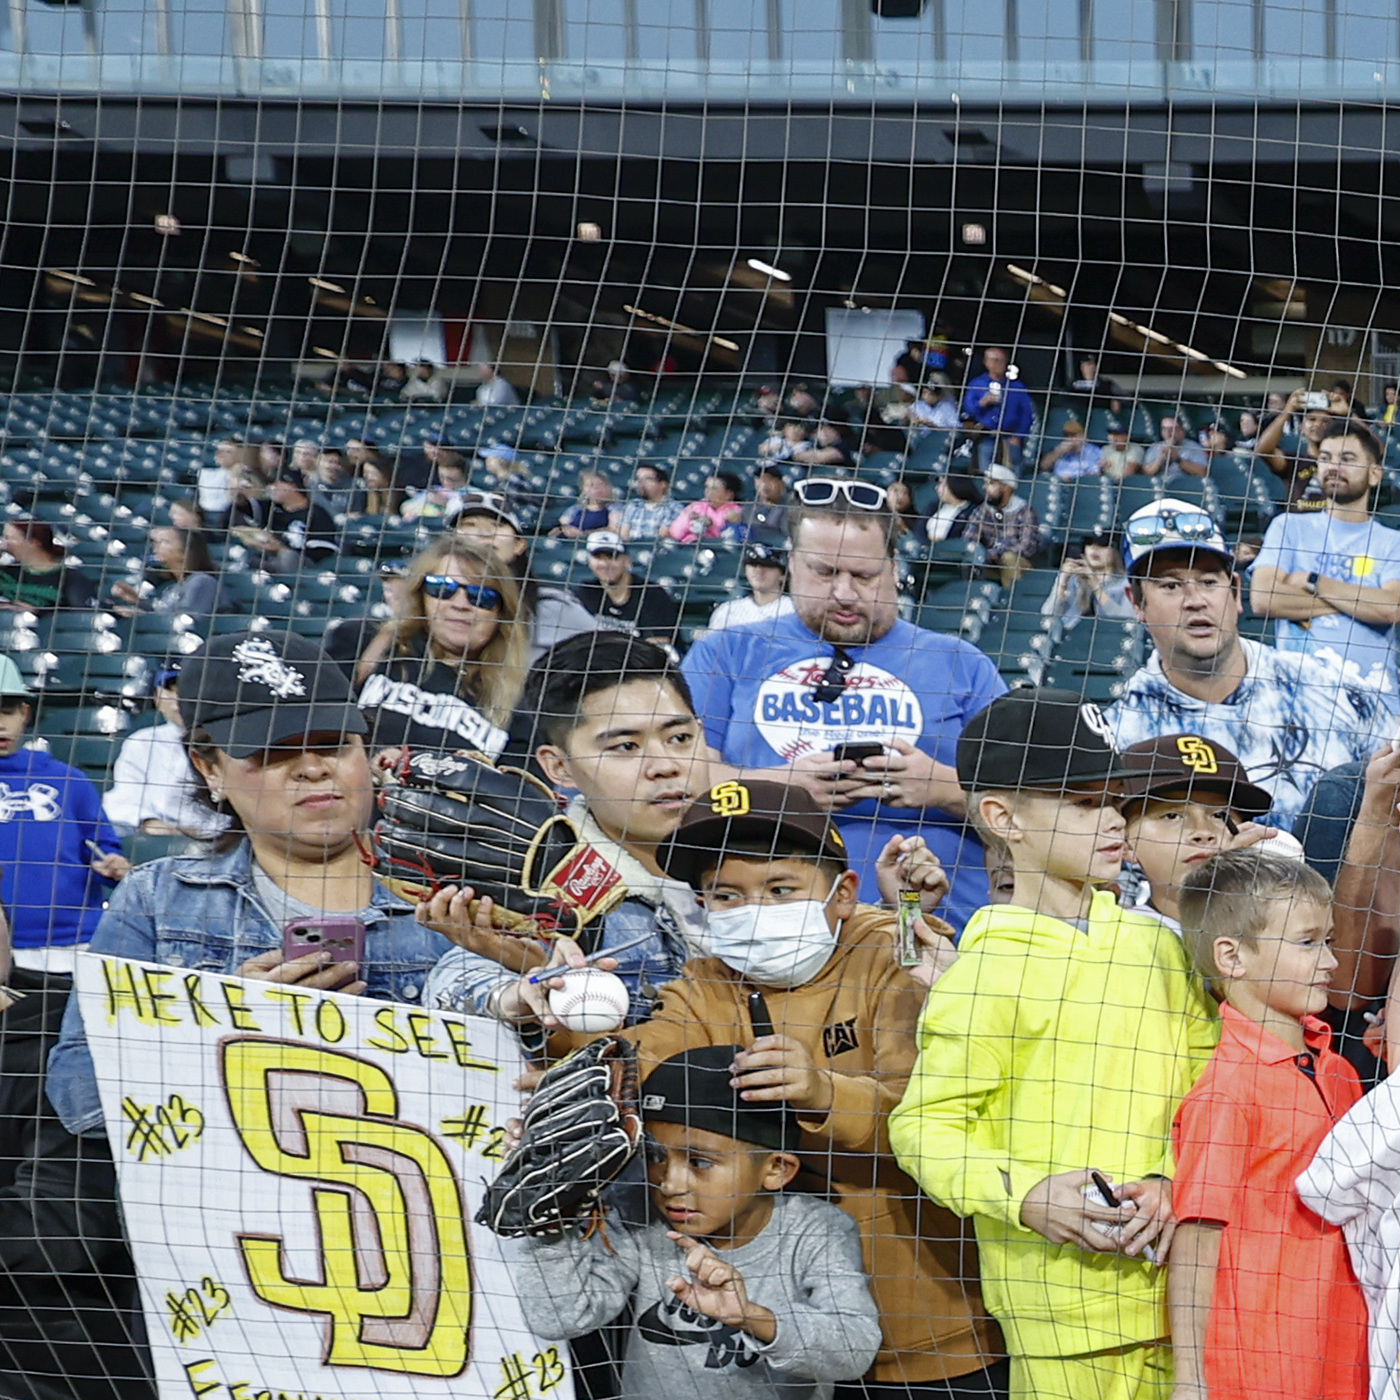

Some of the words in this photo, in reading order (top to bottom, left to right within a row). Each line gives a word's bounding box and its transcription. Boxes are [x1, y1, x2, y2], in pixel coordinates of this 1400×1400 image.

[357, 673, 510, 762] WISCONSIN
[762, 691, 916, 739] BASEBALL
[1176, 736, 1218, 774] SD
[711, 778, 751, 816] SD
[102, 960, 262, 1031] HERE
[265, 990, 345, 1043] TO
[366, 1007, 500, 1072] SEE
[823, 1015, 859, 1058] CAT
[122, 1095, 205, 1162] #23
[441, 1105, 504, 1160] #2
[219, 1036, 474, 1378] SD
[166, 1277, 230, 1342] #23
